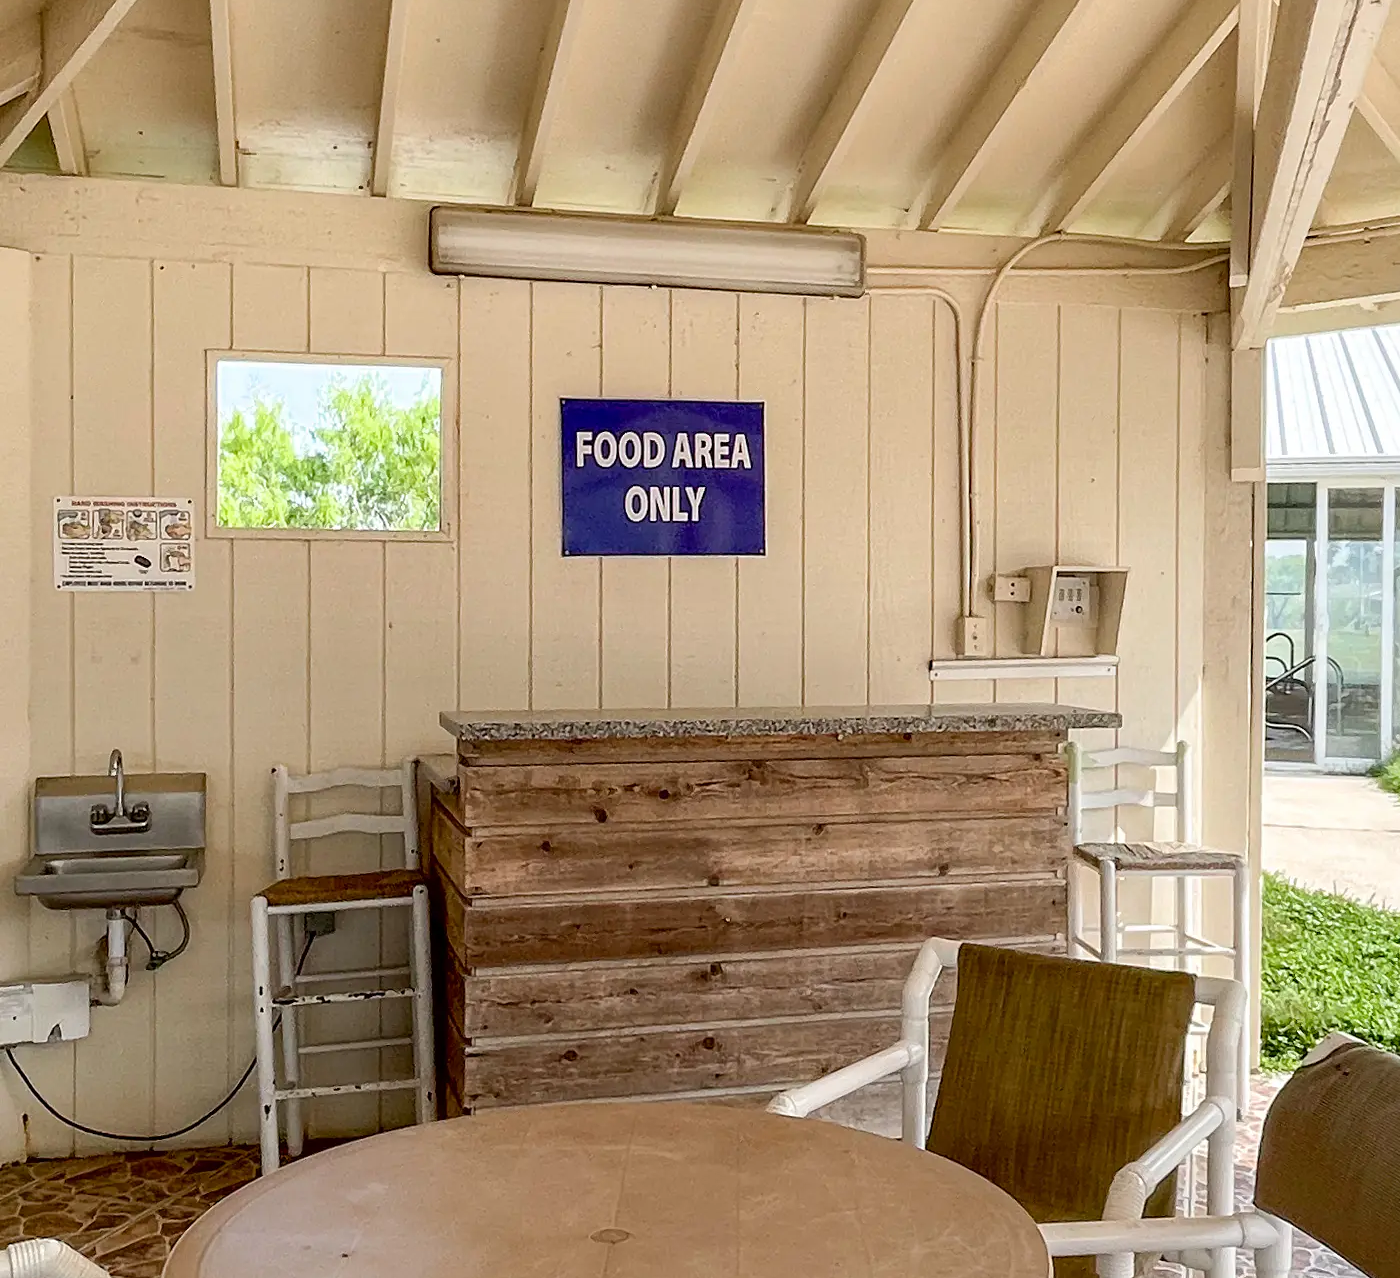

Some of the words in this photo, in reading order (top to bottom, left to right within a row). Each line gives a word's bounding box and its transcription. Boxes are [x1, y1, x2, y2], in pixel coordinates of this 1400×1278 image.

[576, 431, 665, 468] FOOD
[672, 432, 752, 469] AREA
[624, 485, 706, 522] ONLY
